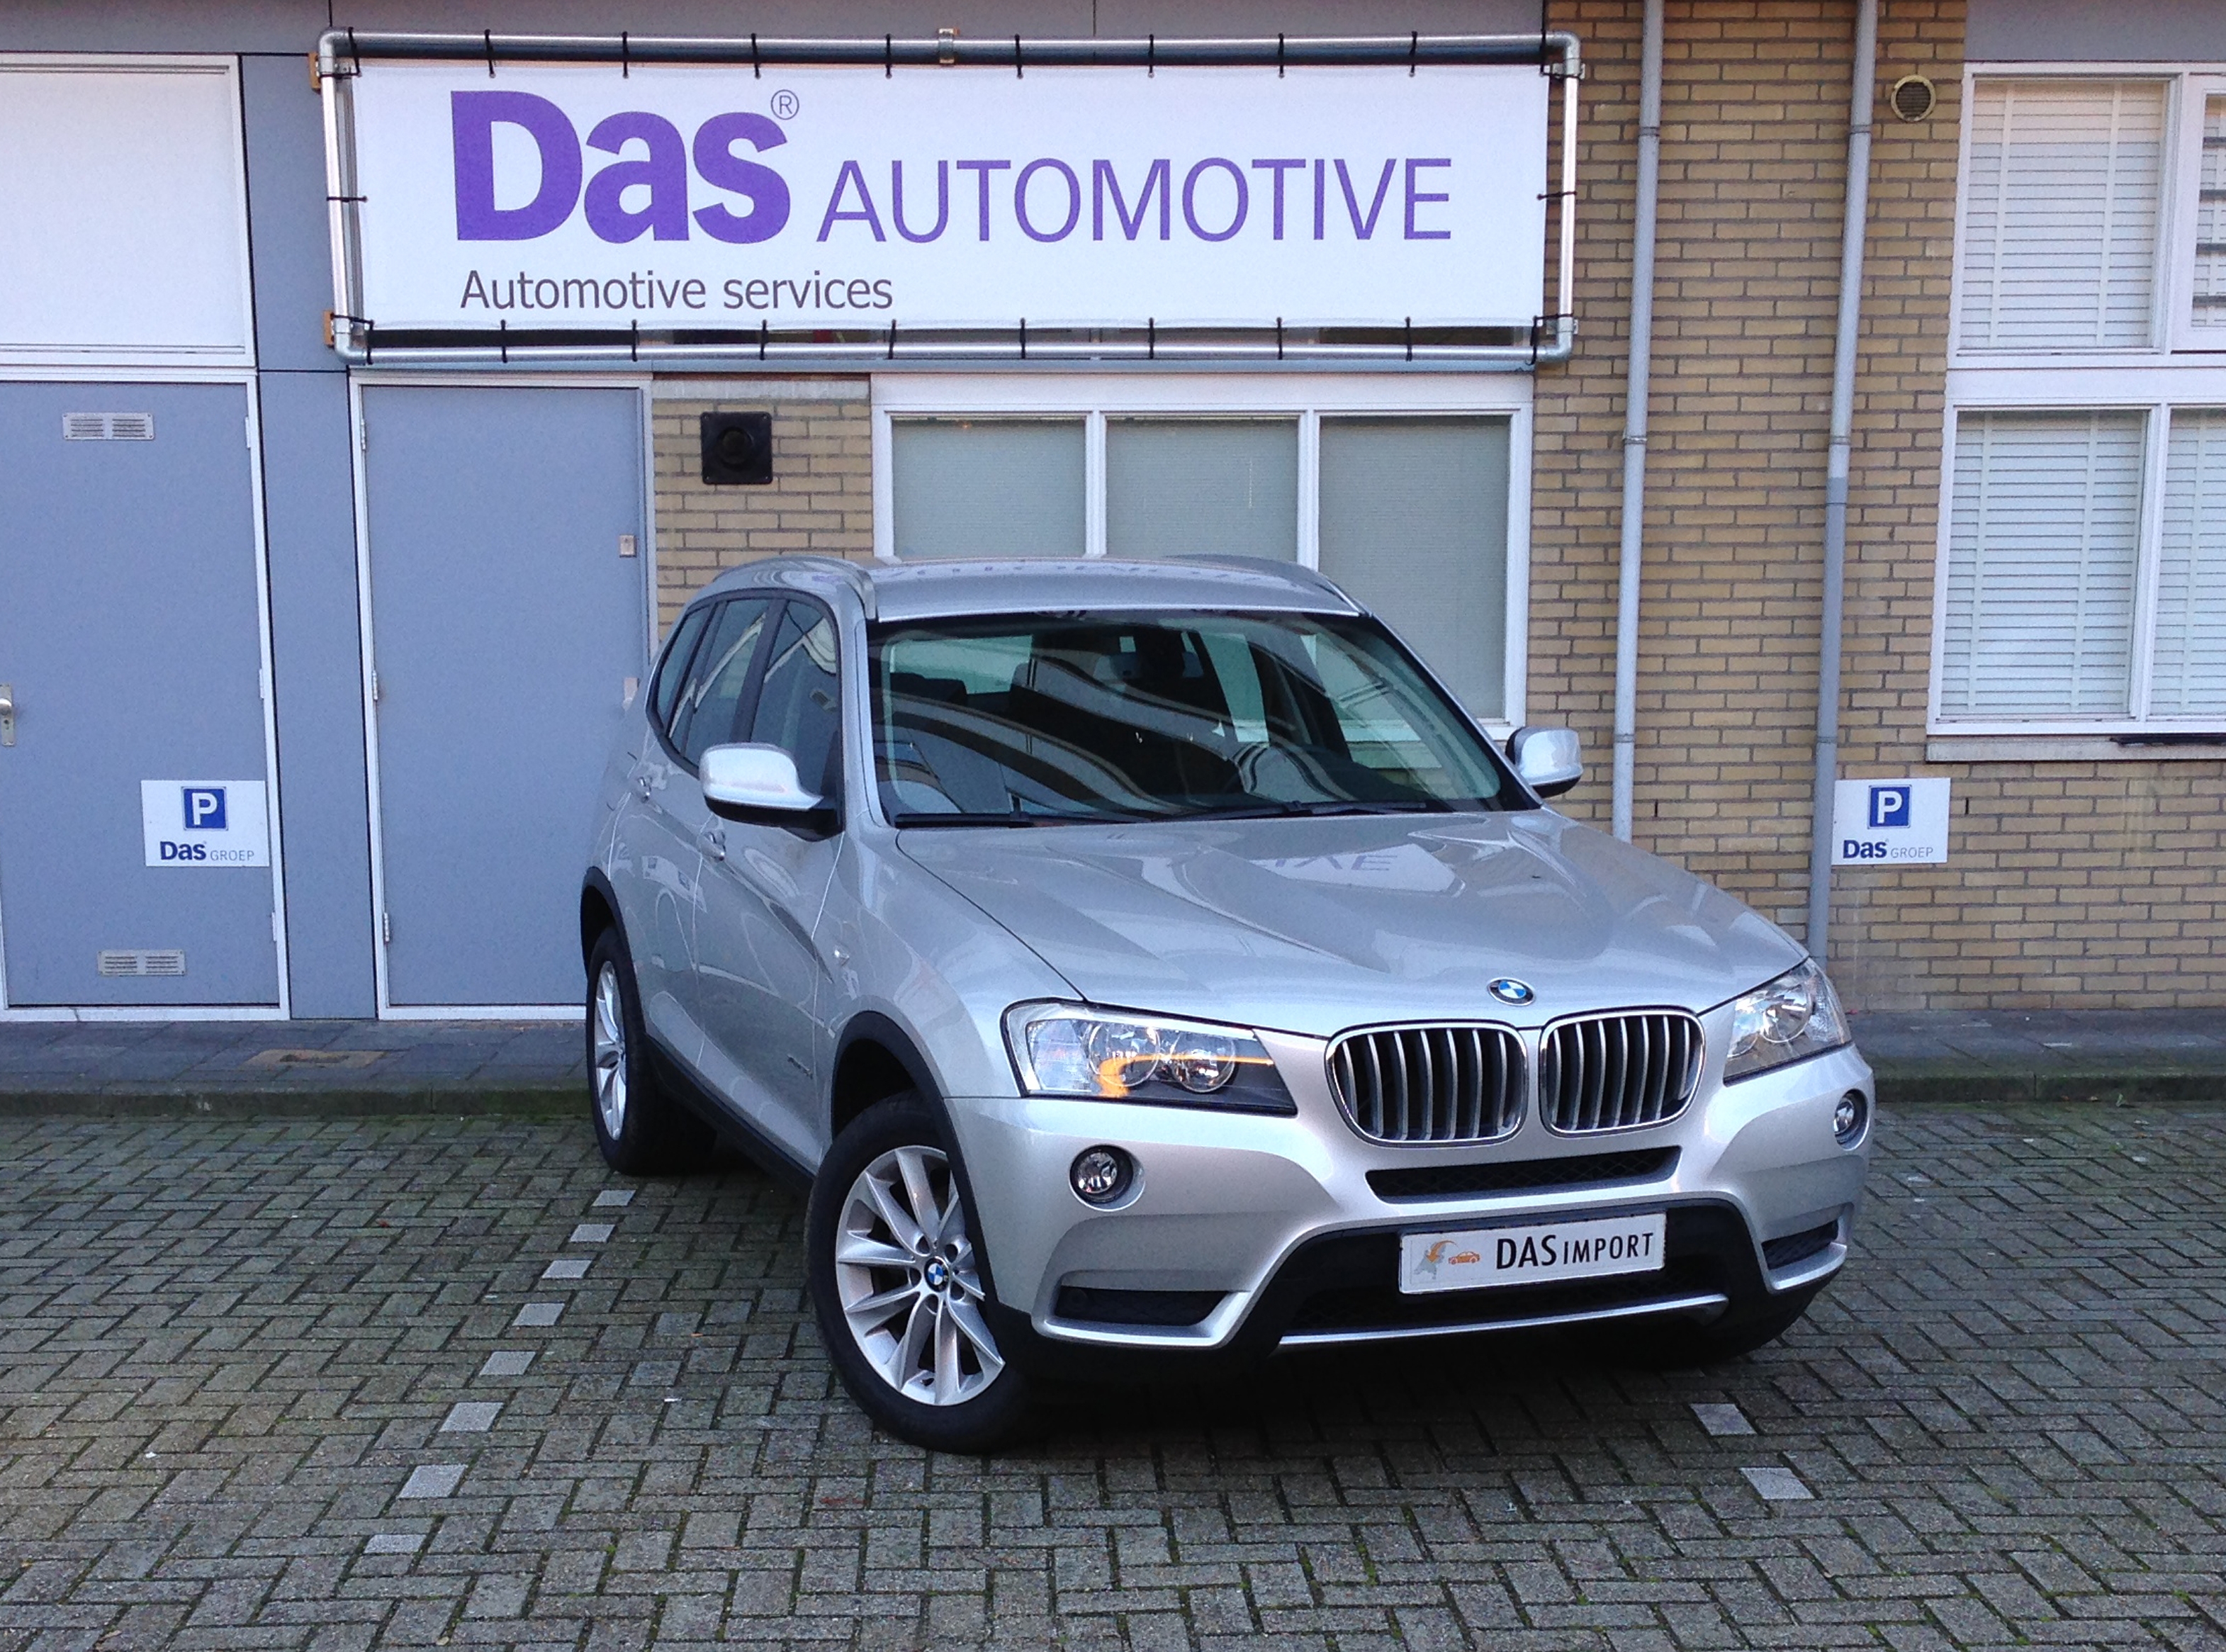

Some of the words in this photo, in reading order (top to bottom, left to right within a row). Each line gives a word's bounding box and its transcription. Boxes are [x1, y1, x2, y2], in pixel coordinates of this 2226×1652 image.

[816, 157, 1451, 244] AUTOMOTIVE
[461, 270, 705, 309] Automotive
[724, 271, 892, 309] services
[192, 792, 218, 826] P
[1877, 790, 1903, 824] P
[160, 841, 206, 860] Das
[210, 850, 254, 861] GROEP
[1843, 840, 1887, 858] Das
[1891, 847, 1933, 858] GROEP
[1496, 1235, 1557, 1269] DAS
[1563, 1232, 1653, 1264] IMPORT
